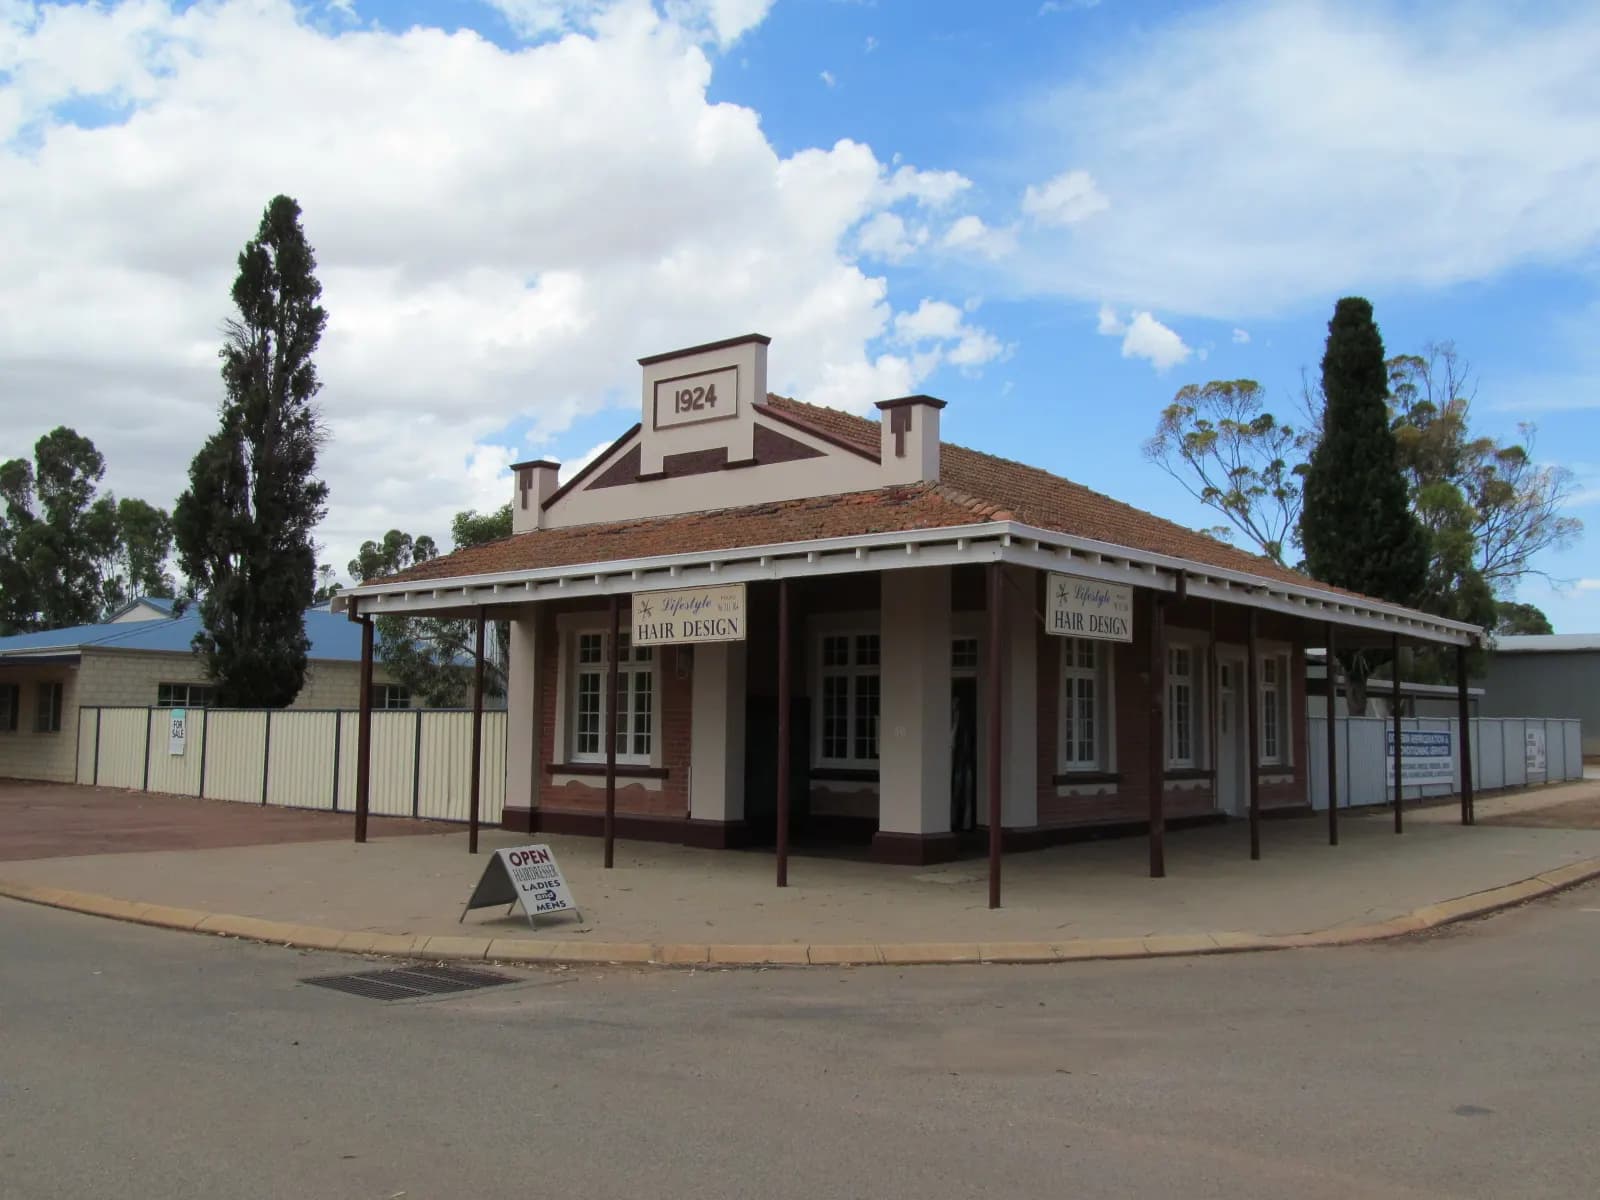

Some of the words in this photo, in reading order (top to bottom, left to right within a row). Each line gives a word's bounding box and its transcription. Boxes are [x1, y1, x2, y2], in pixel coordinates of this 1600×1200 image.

[675, 383, 717, 413] 1924
[1073, 584, 1110, 608] Lifestyle
[663, 595, 712, 616] Lifestyle
[638, 622, 674, 640] HAIR
[683, 618, 738, 637] DESIGN
[1055, 610, 1084, 631] HAIR
[1089, 614, 1128, 635] DESIGN
[173, 720, 183, 728] FOR
[172, 728, 184, 738] SALE
[509, 849, 550, 866] OPEN
[513, 865, 559, 882] HAIRDRESSER
[522, 880, 560, 891] LADIES
[537, 901, 566, 911] MENS
